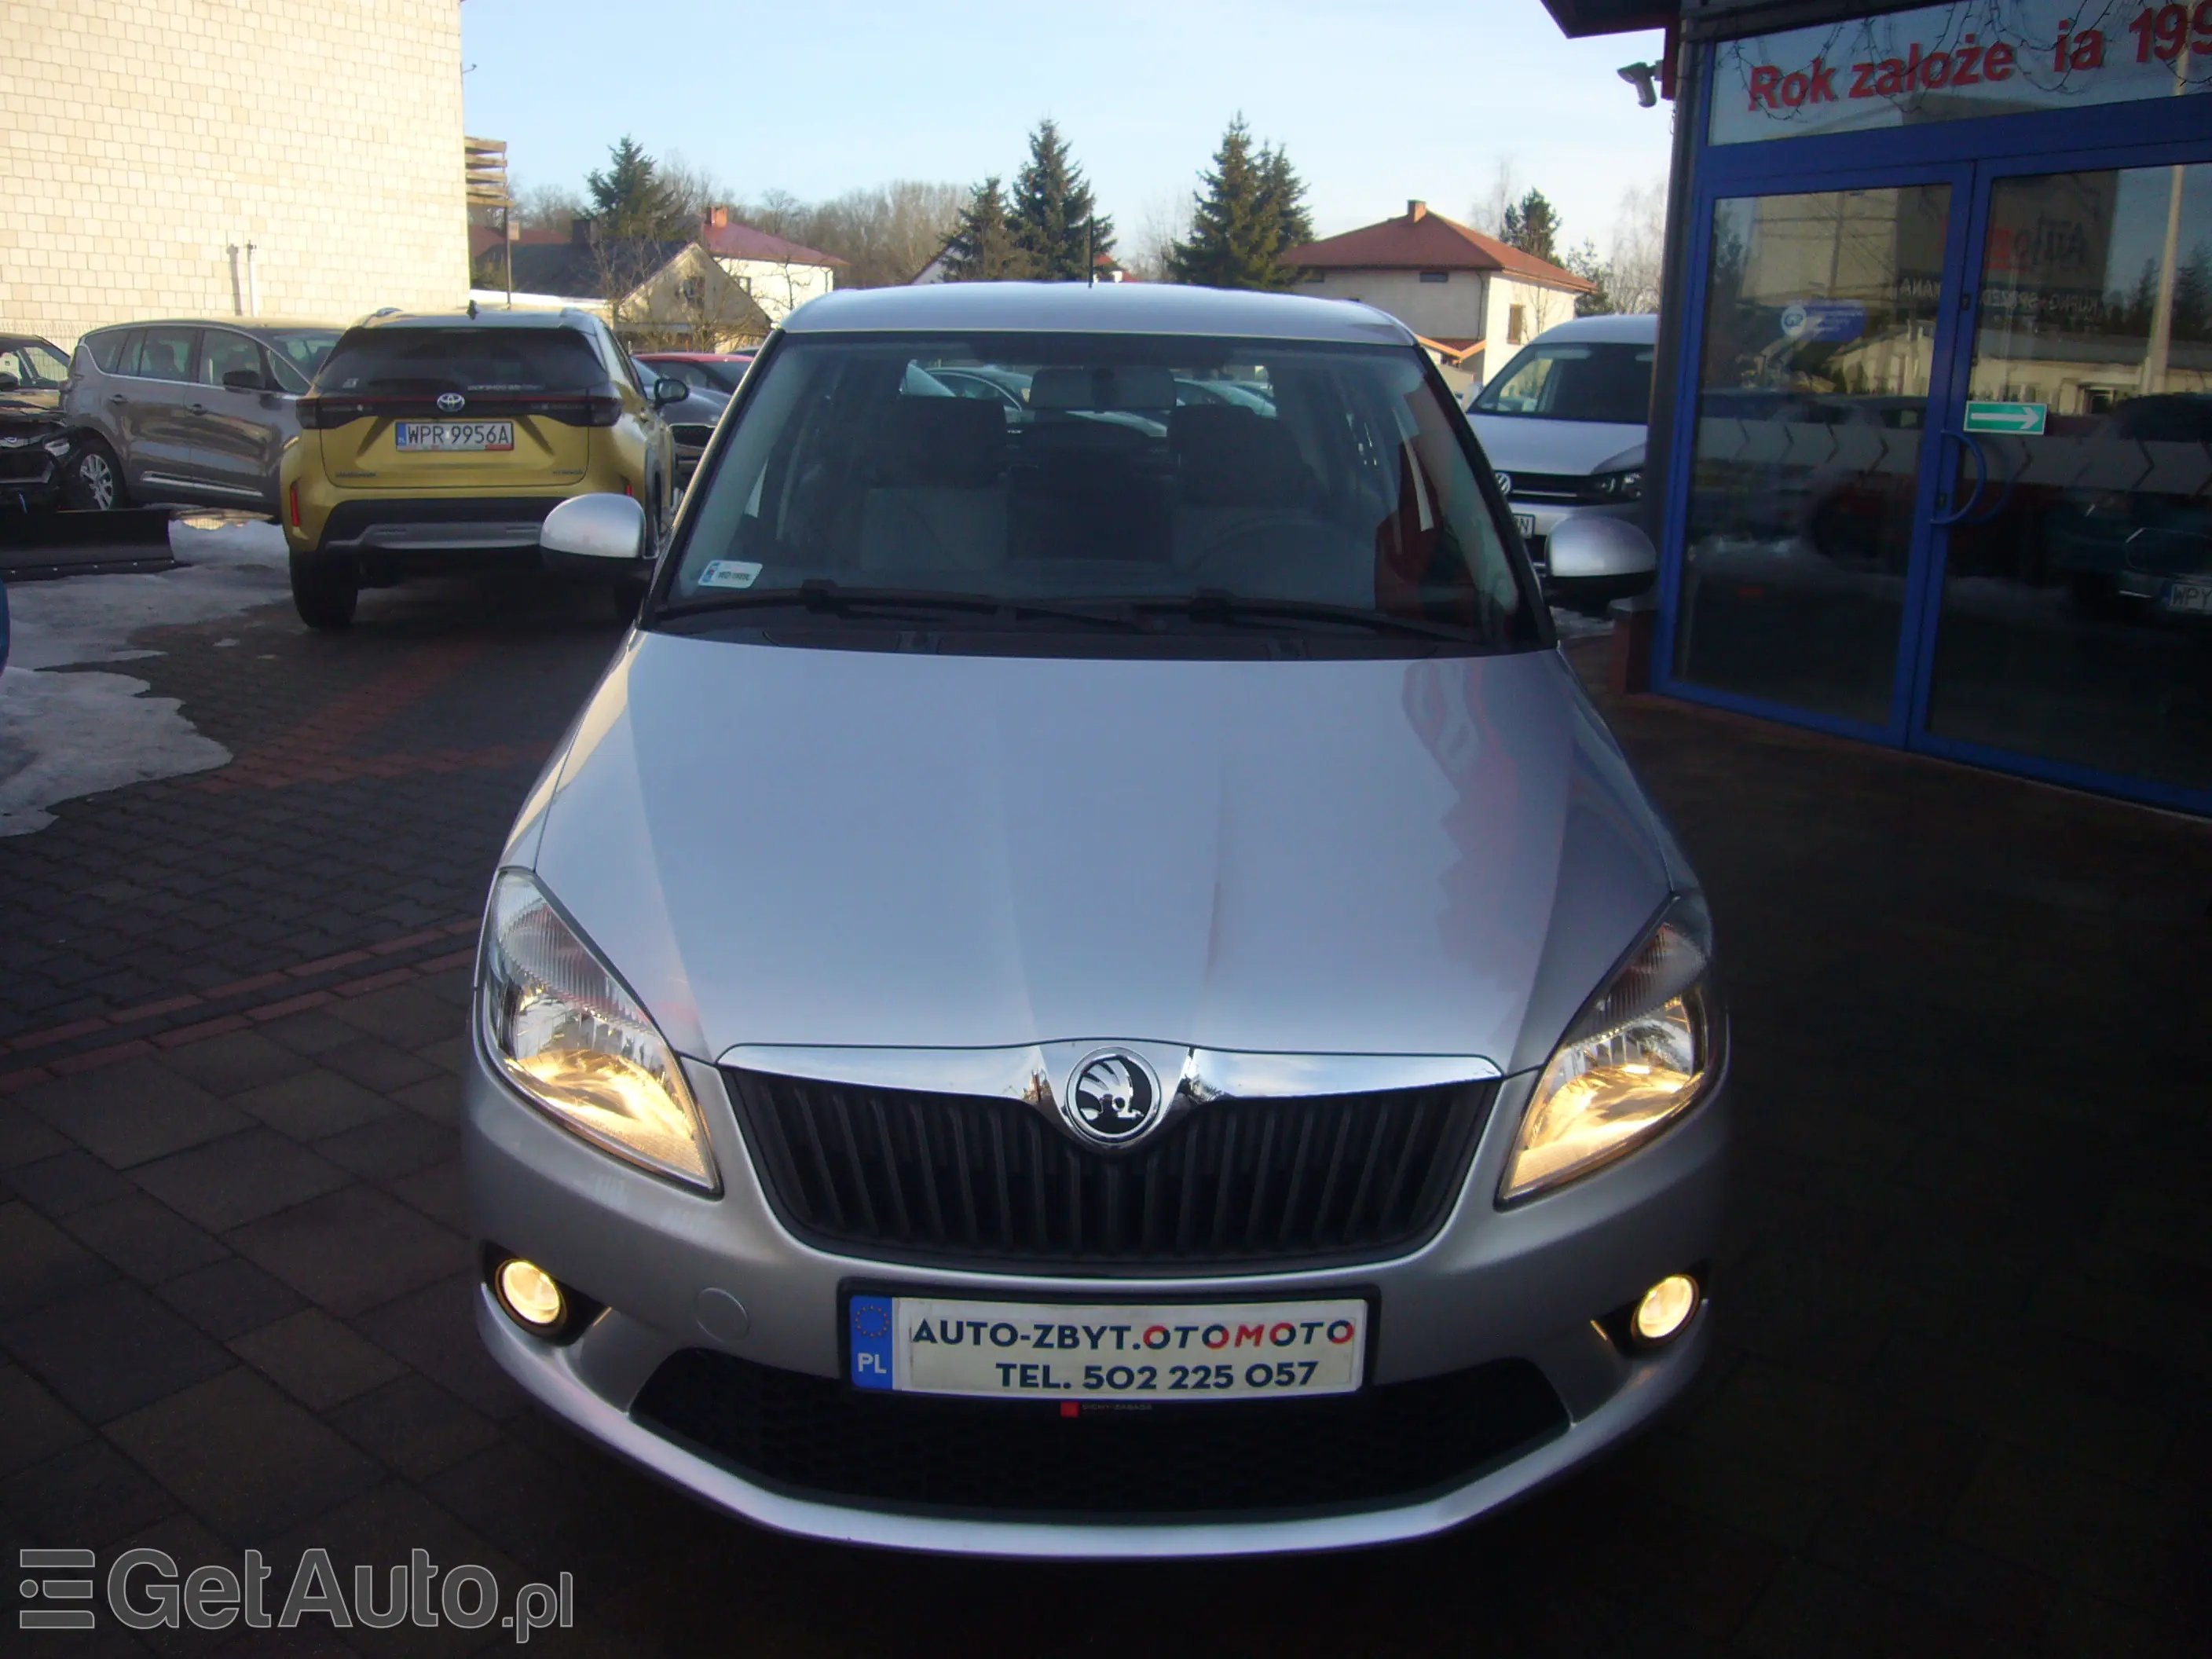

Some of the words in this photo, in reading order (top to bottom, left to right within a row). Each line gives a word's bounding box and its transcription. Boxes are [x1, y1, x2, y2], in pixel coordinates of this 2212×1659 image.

[1749, 57, 1837, 112] Rok
[407, 425, 444, 444] WPR
[450, 424, 509, 444] 9956A
[912, 1319, 1355, 1350] AUTO-ZBYT.OTOMOTO
[857, 1352, 887, 1374] PL
[995, 1363, 1072, 1390] TEL.
[1082, 1365, 1158, 1391] 502
[1168, 1364, 1234, 1390] 225
[1245, 1361, 1319, 1389] 057
